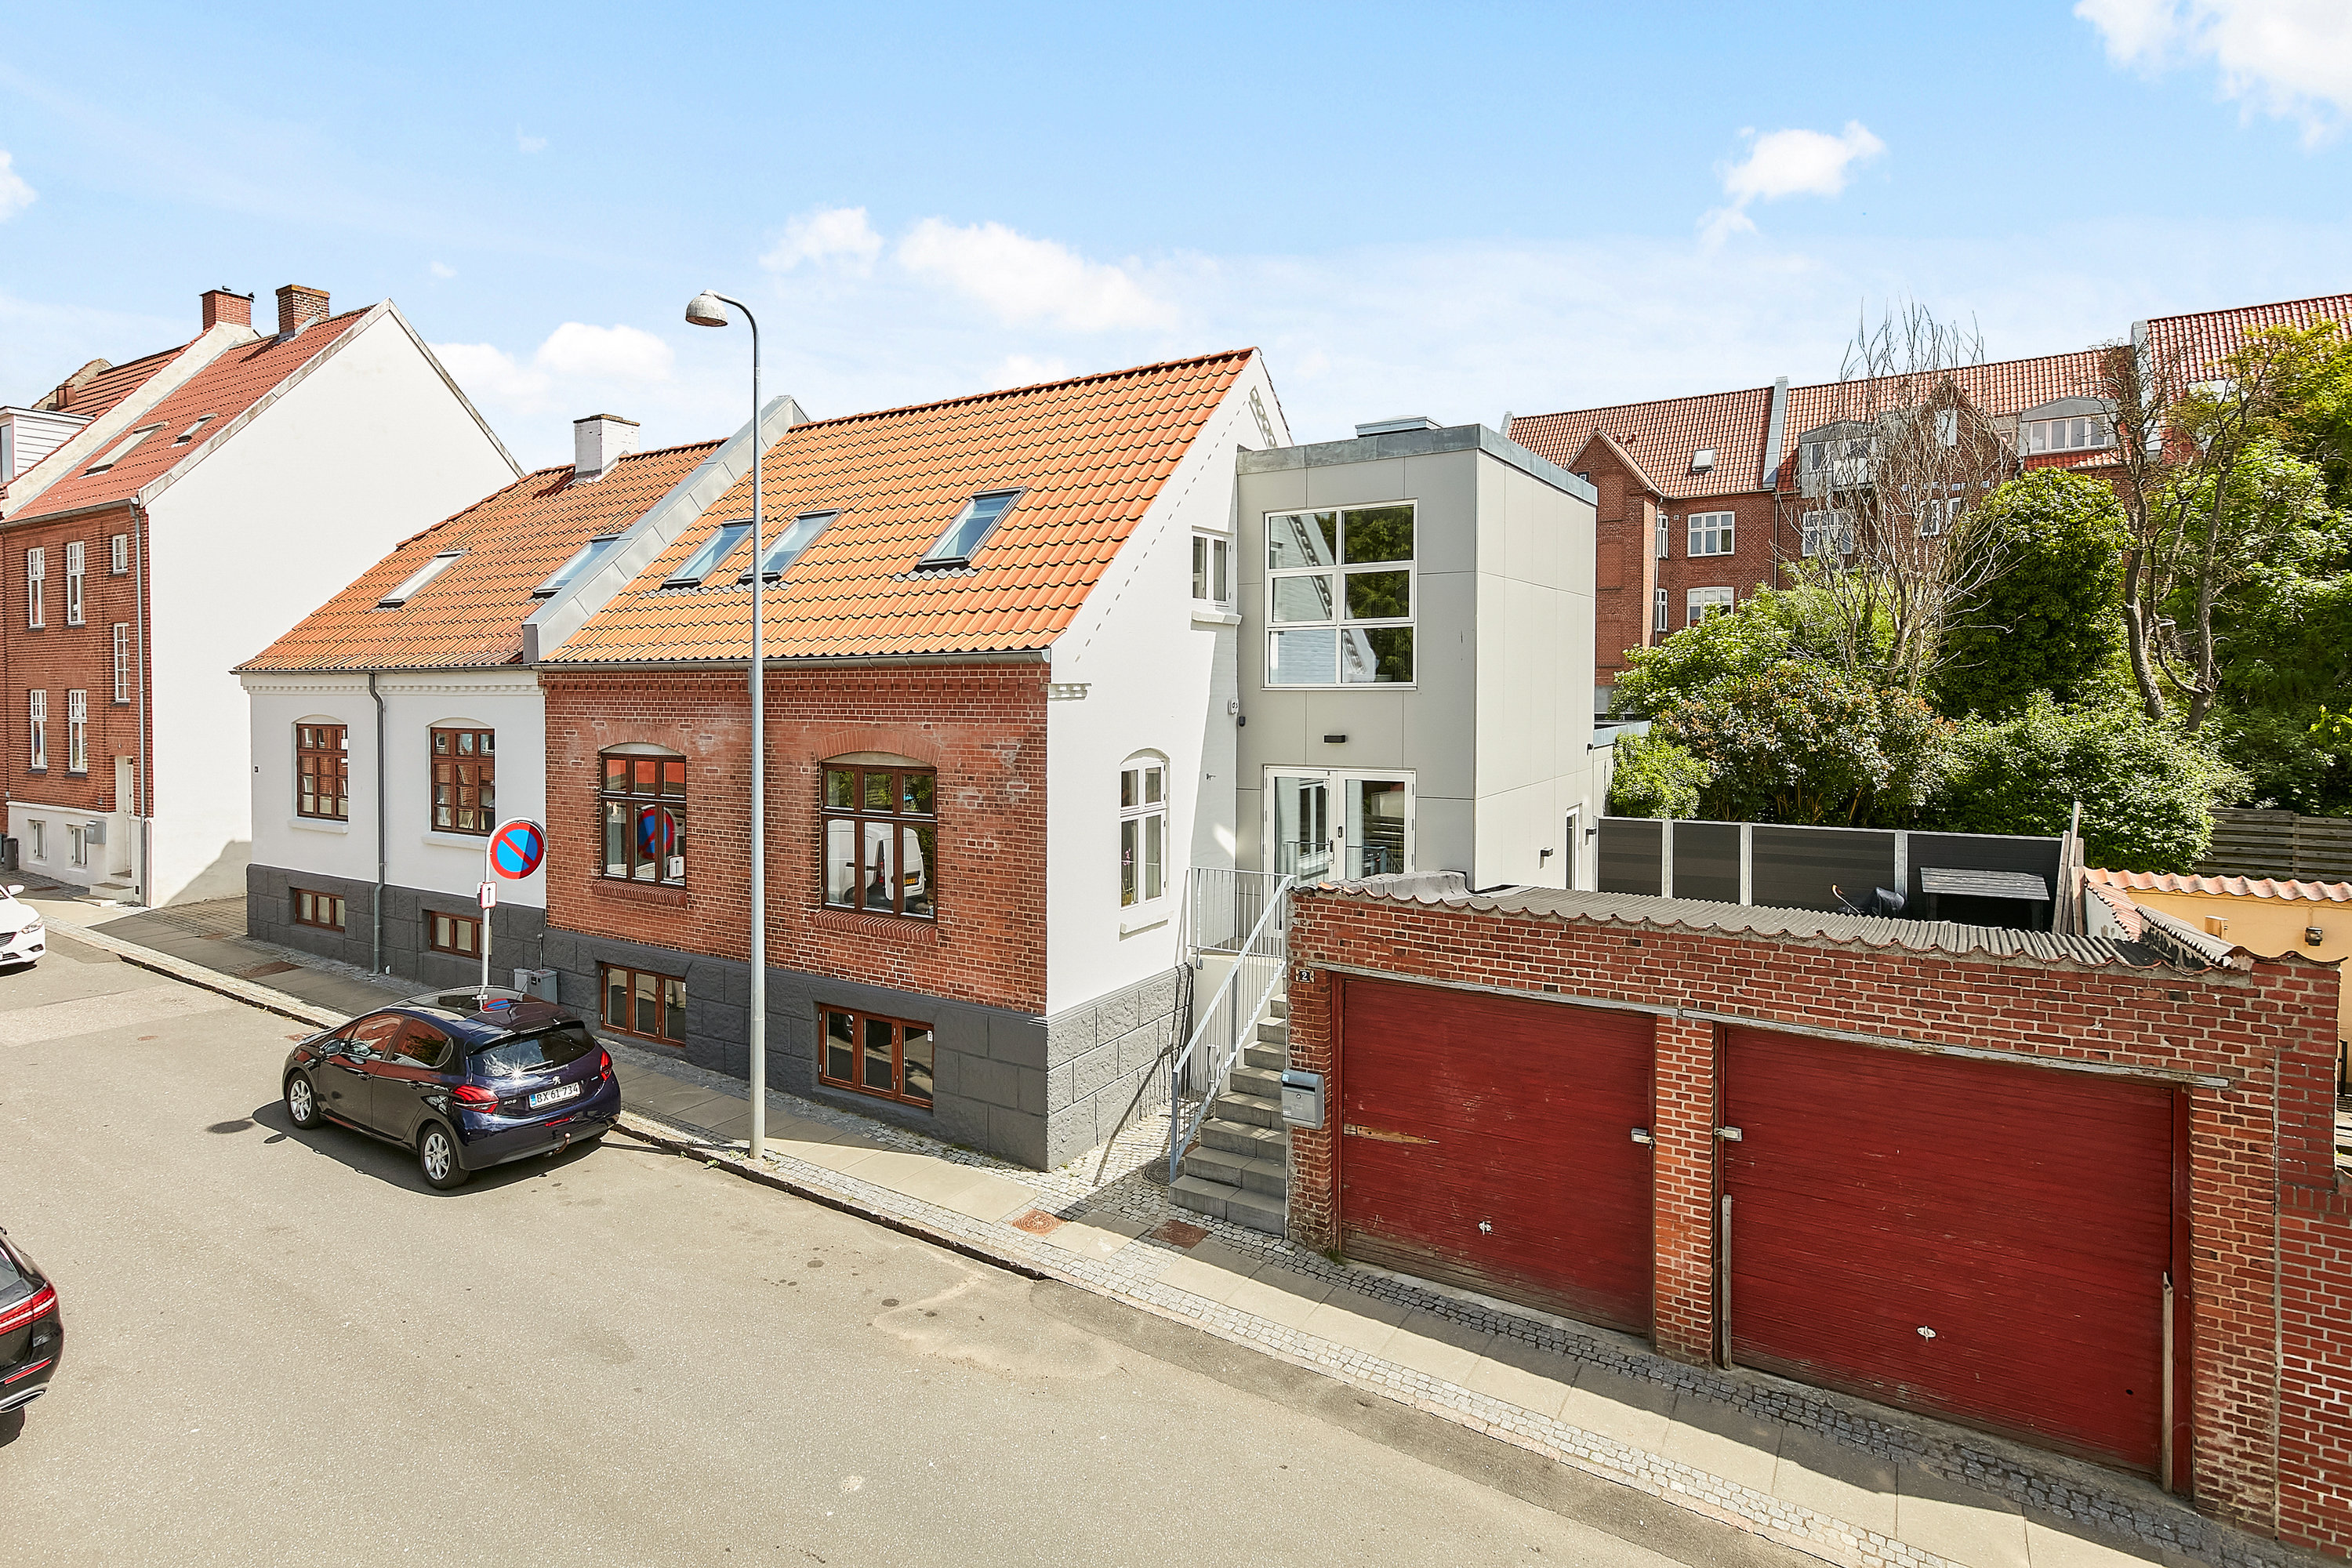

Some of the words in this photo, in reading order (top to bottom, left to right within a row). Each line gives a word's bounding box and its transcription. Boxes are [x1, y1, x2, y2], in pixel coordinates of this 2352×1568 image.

[1301, 971, 1308, 980] 2
[536, 1093, 549, 1103] BX
[550, 1090, 561, 1098] 61
[564, 1085, 579, 1096] 734
